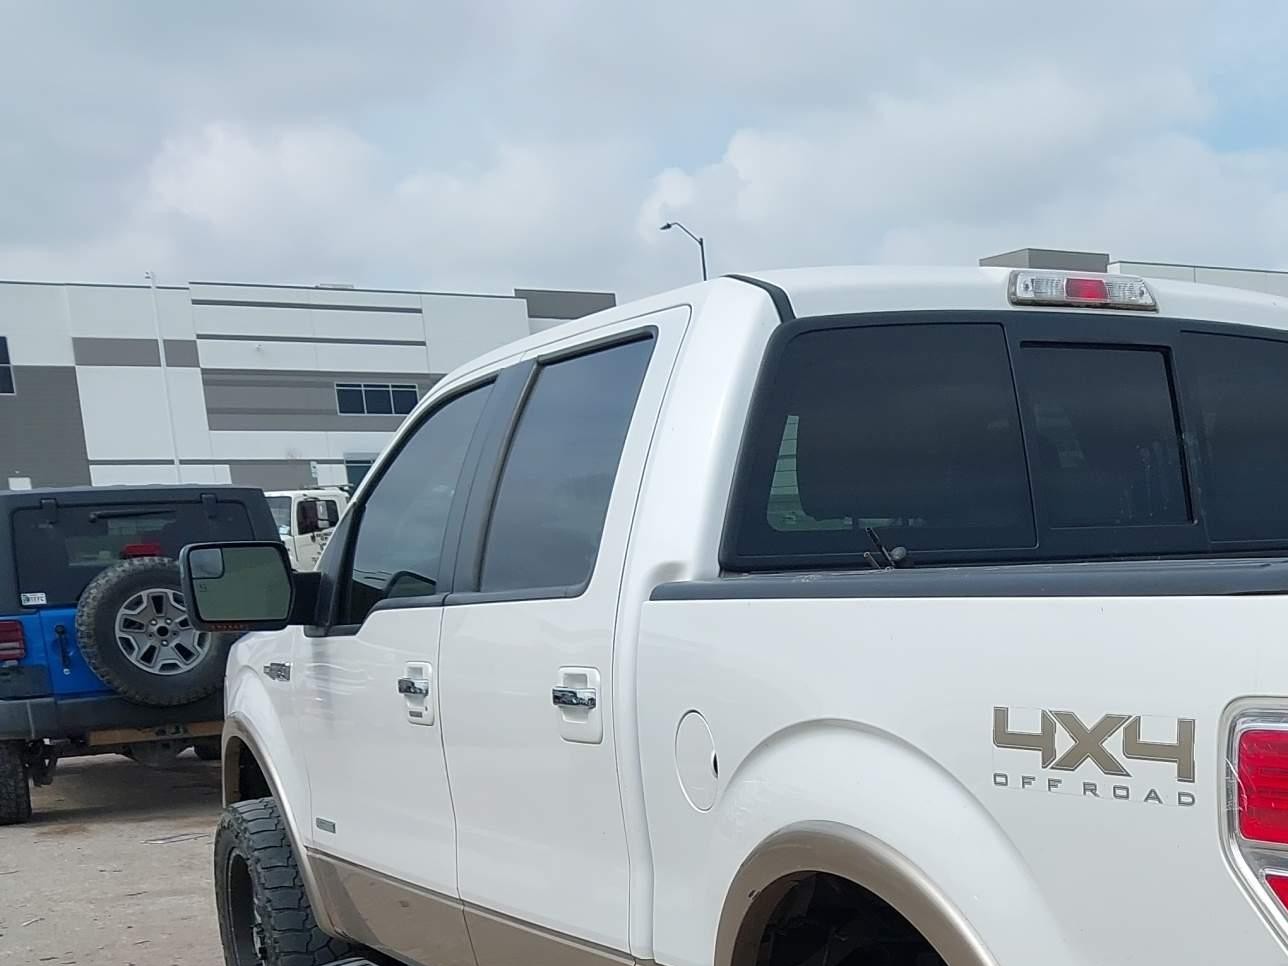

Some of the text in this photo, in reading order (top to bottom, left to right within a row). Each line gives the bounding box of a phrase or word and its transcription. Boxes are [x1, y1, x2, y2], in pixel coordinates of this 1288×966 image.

[993, 707, 1195, 783] 4X4
[993, 773, 1196, 806] OFF ROAD
